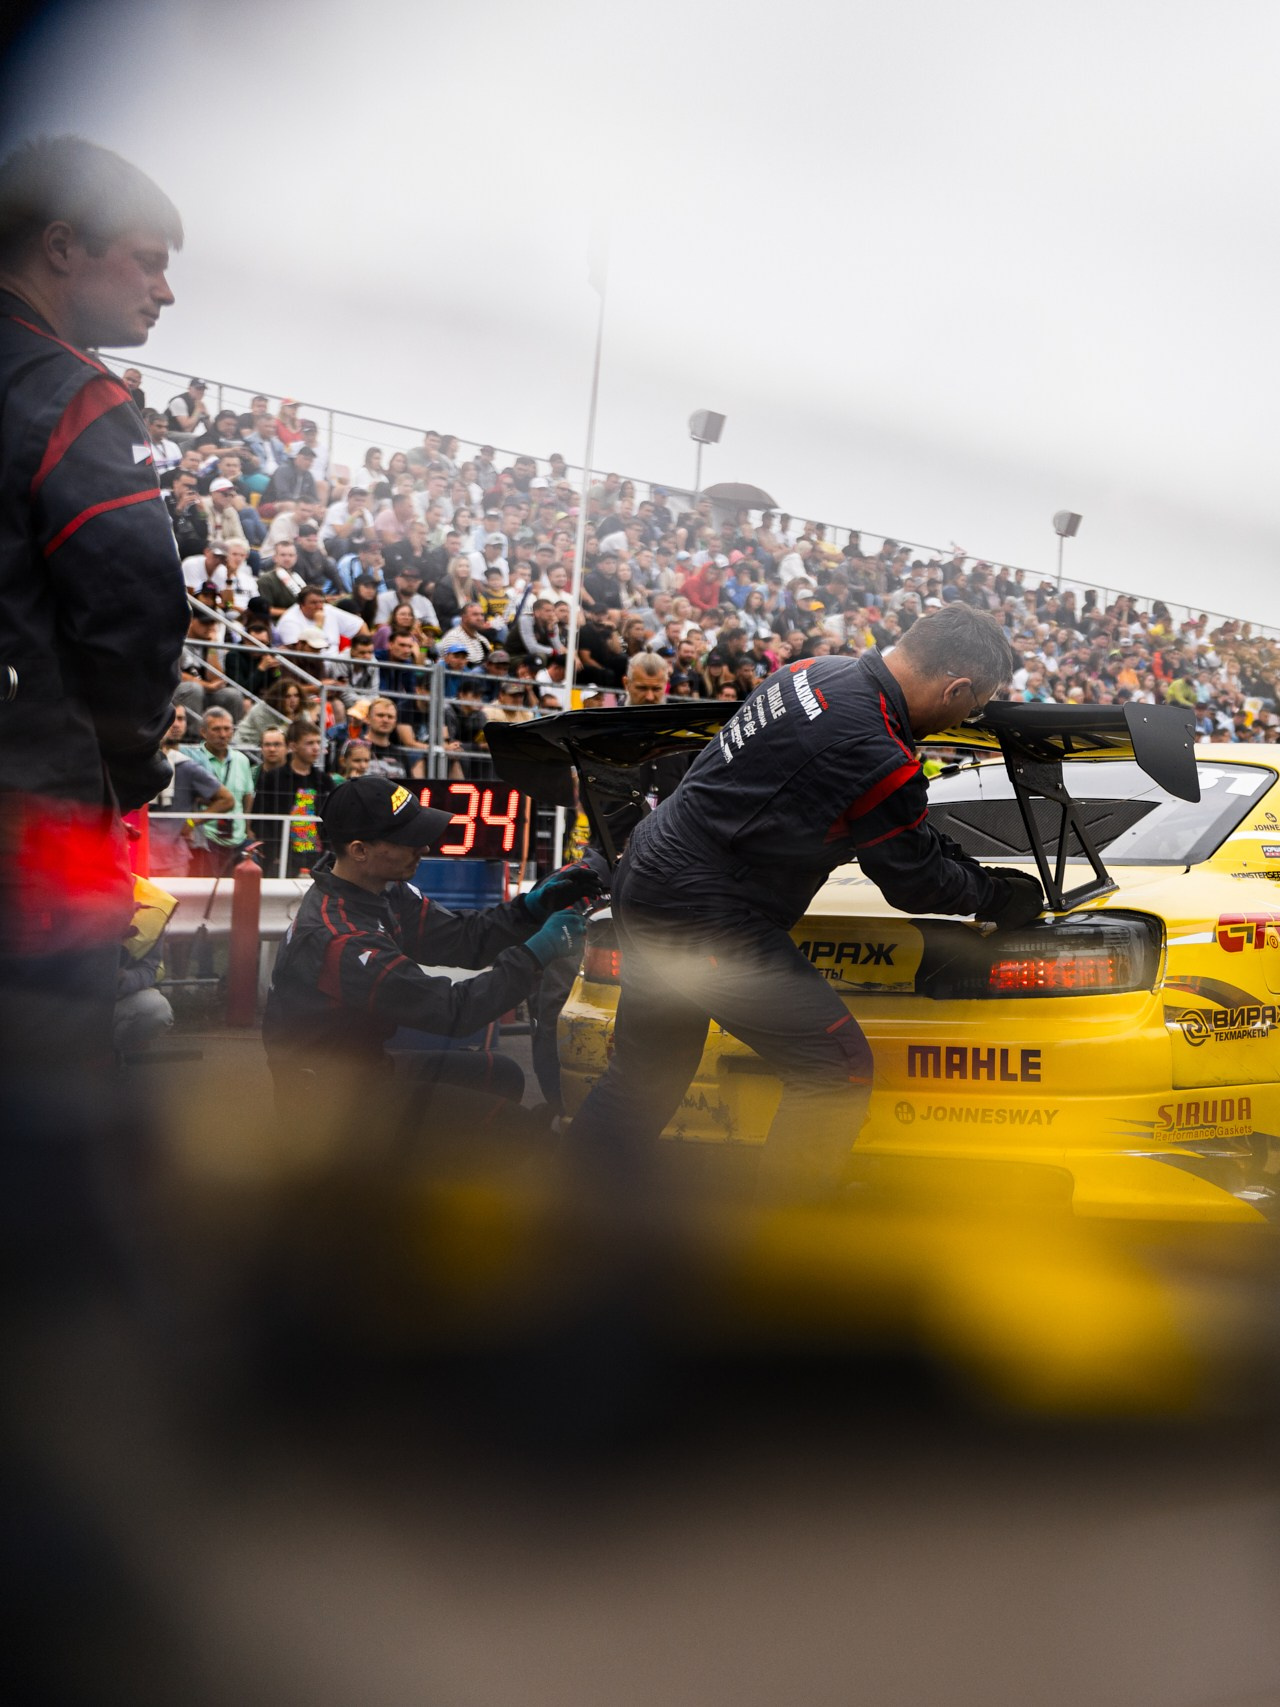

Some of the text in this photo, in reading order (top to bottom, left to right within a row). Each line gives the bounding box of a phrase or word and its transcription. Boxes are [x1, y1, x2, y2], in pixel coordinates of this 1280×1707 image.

[767, 682, 787, 720] MAHLE
[793, 669, 822, 721] TAKAYAMA
[799, 941, 898, 966] ИРАЖ
[1215, 1029, 1269, 1042] ТЕХМАРКЕТЫ
[908, 1045, 1041, 1082] MAHLE
[920, 1105, 1060, 1125] JONNESWAY
[1157, 1097, 1251, 1128] SIRUDA
[1155, 1125, 1253, 1141] Performance Gaskets
